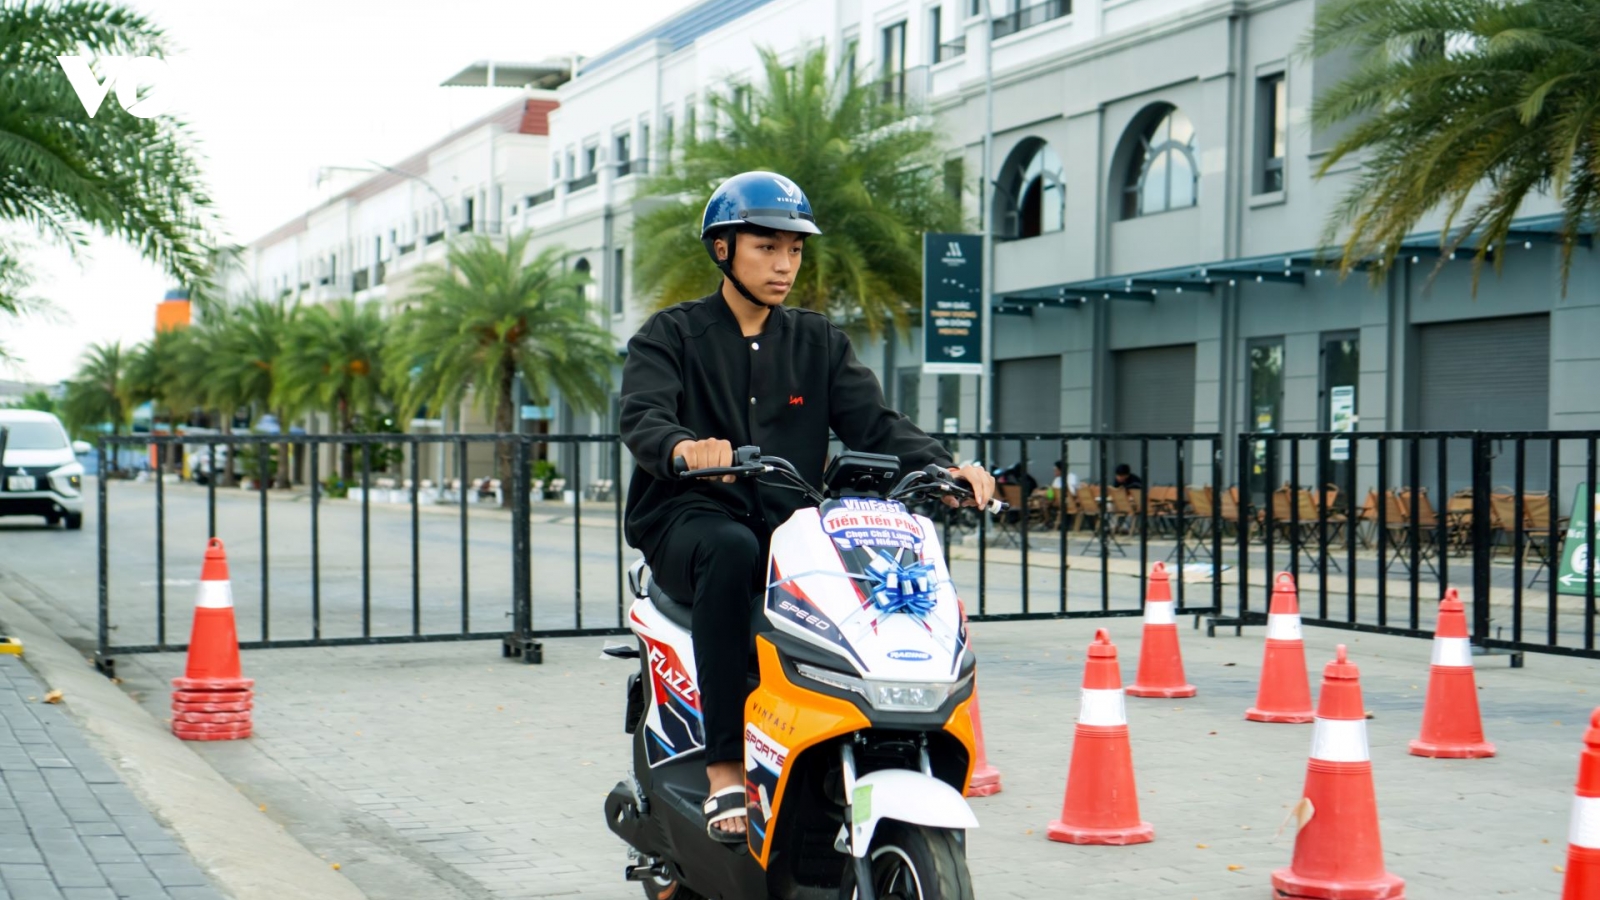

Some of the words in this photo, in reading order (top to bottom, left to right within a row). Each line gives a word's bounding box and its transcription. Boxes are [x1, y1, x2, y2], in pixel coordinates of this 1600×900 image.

[843, 499, 900, 512] VinFast
[827, 514, 859, 530] Tiến
[861, 514, 892, 527] Tiến
[845, 530, 869, 539] Chọn
[778, 600, 831, 631] SPEED
[890, 651, 930, 660] RACING
[650, 645, 697, 701] FLAZZ
[752, 702, 796, 736] VINFAST
[744, 728, 786, 768] SPORTS
